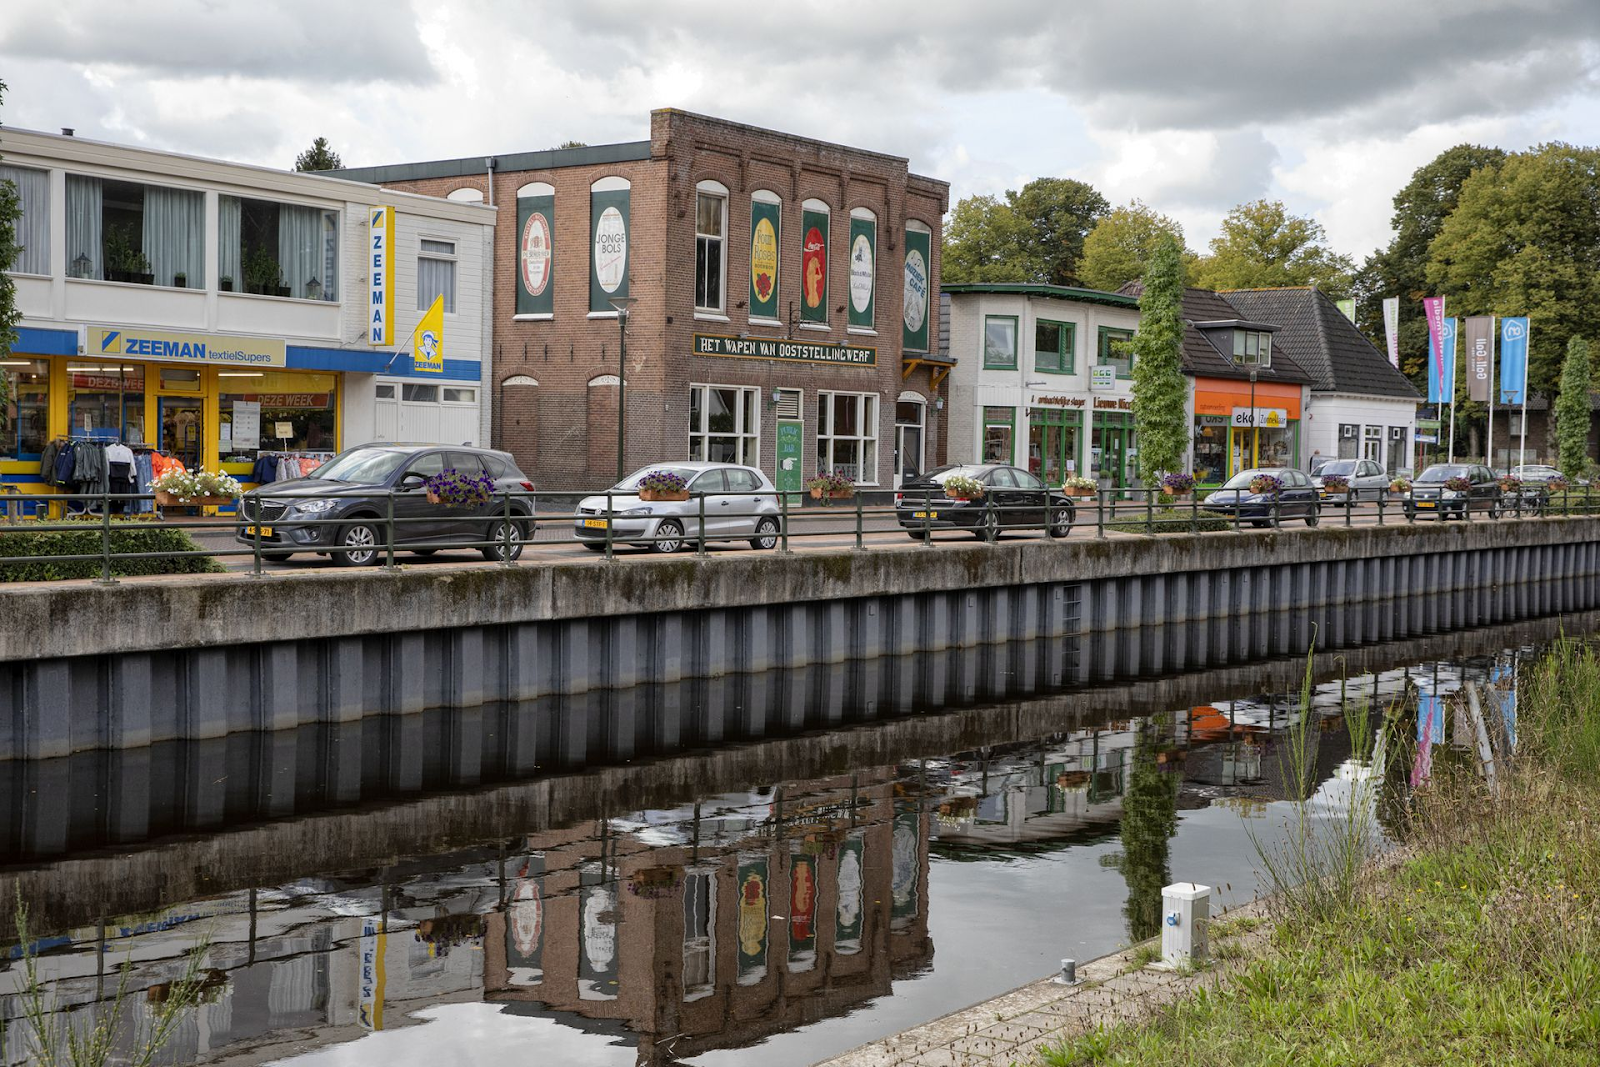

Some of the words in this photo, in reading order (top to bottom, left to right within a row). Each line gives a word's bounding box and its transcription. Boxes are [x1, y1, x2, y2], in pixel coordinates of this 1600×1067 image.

[596, 233, 625, 244] JONGE
[602, 243, 622, 254] BOLS
[372, 235, 383, 341] ZEEMAN
[125, 338, 206, 358] ZEEMAN
[208, 350, 271, 363] textielSupers
[700, 337, 720, 352] HET
[725, 338, 756, 354] WAPEN
[760, 342, 776, 356] VAN
[414, 361, 442, 370] ZEEMAN
[257, 394, 284, 406] DEZE
[285, 394, 314, 406] WEEK
